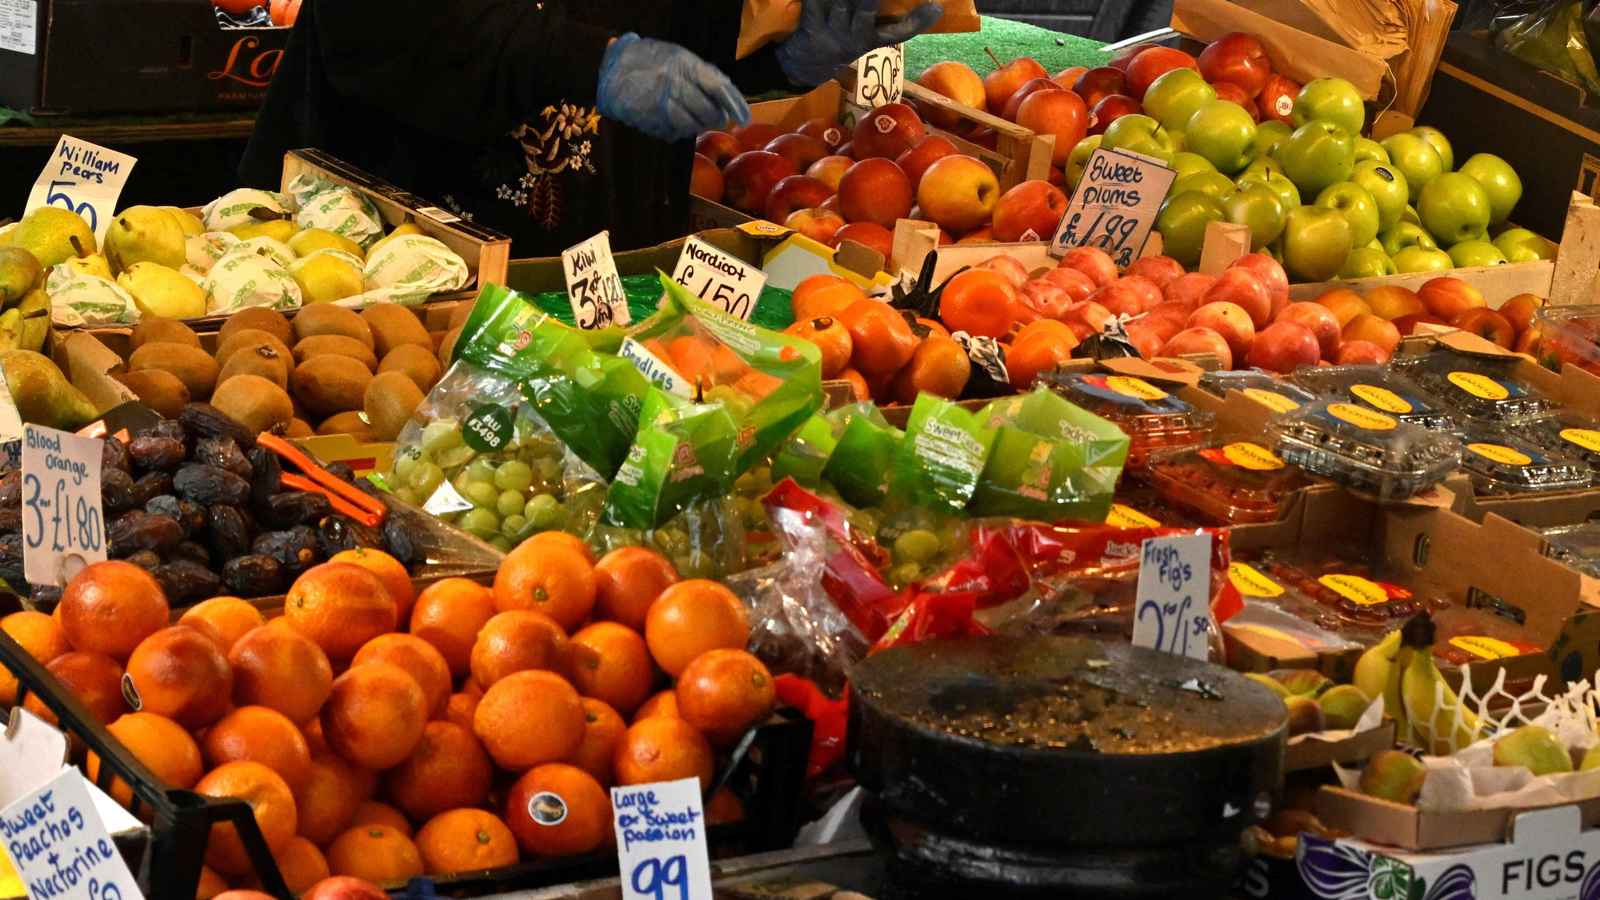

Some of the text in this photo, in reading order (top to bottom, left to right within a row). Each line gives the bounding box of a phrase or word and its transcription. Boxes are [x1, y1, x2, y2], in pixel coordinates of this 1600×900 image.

[59, 140, 119, 174] William
[1089, 154, 1143, 183] Sweet
[1081, 186, 1141, 210] plums
[571, 277, 598, 330] 3
[26, 427, 61, 454] Blood
[1143, 540, 1178, 566] Fresh
[0, 790, 55, 839] Sweet
[615, 791, 660, 817] Large
[631, 854, 689, 900] 99
[1502, 850, 1586, 895] FIGS
